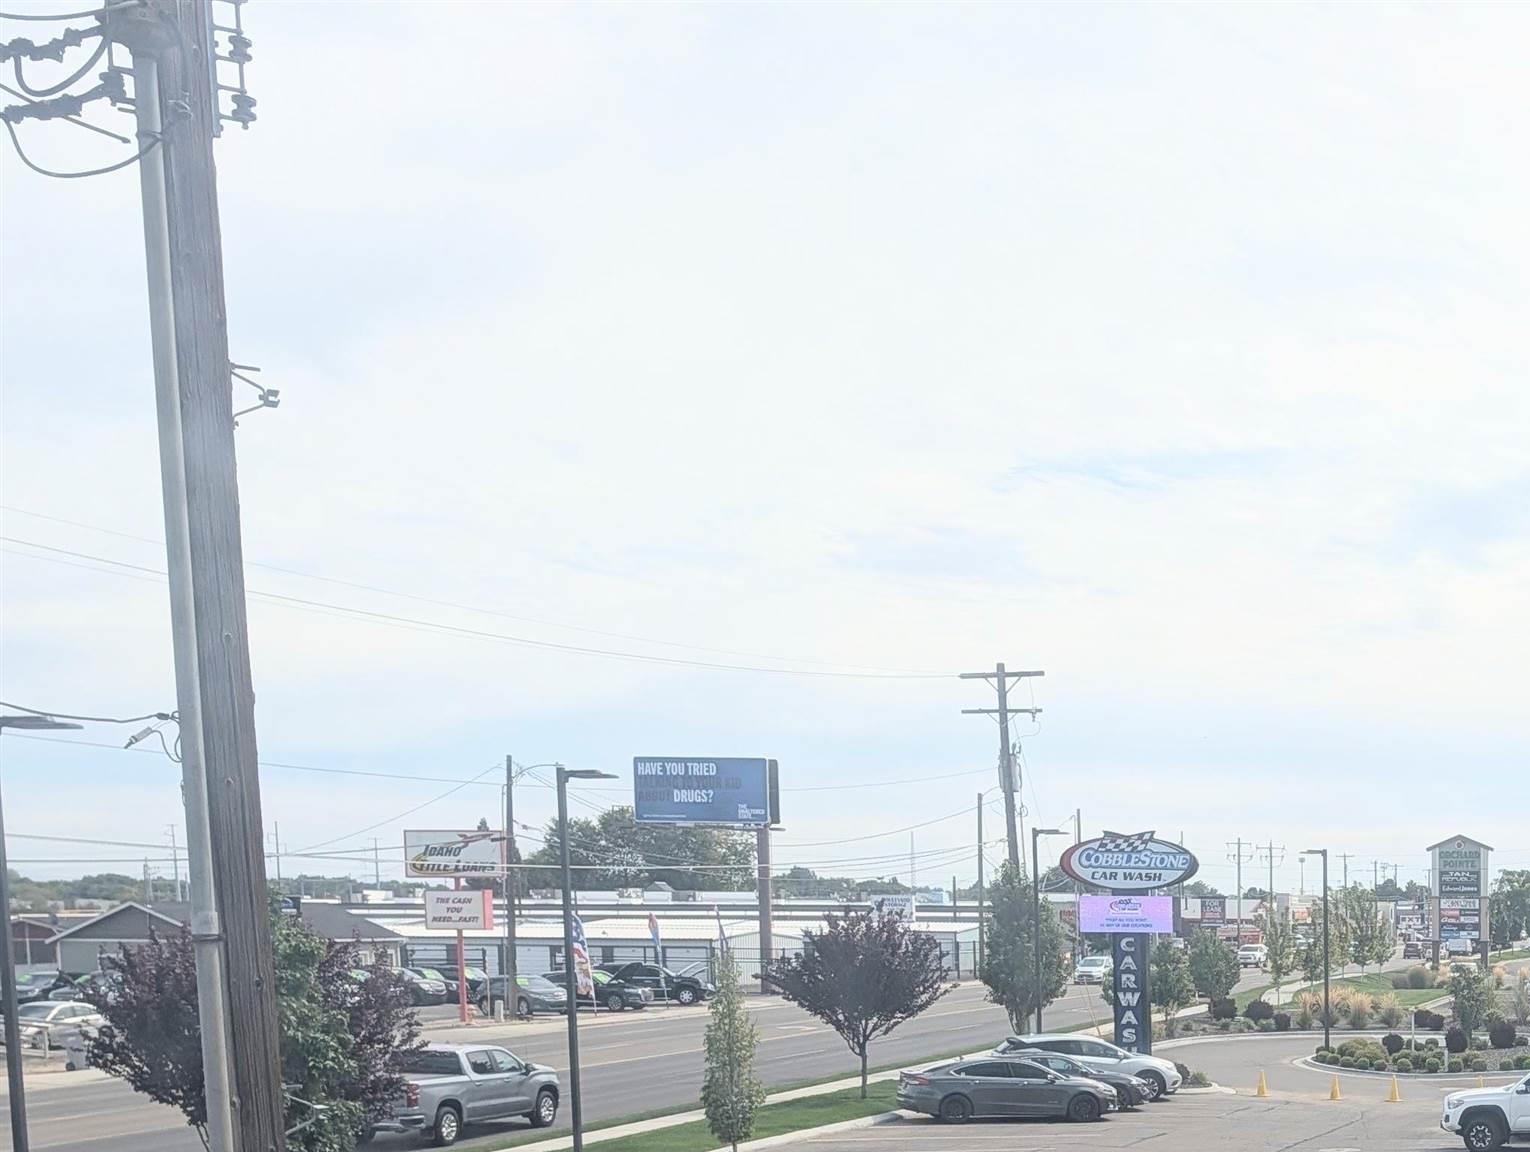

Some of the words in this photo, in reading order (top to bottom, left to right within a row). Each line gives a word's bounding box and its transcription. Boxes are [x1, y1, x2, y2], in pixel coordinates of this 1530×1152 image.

[638, 762, 663, 776] HAVE
[665, 762, 684, 776] YOU
[687, 762, 716, 776] TRIED
[674, 789, 714, 802] DRUGS?
[423, 844, 461, 856] IDAHO
[1091, 870, 1118, 880] CAR
[1123, 871, 1162, 882] WASH
